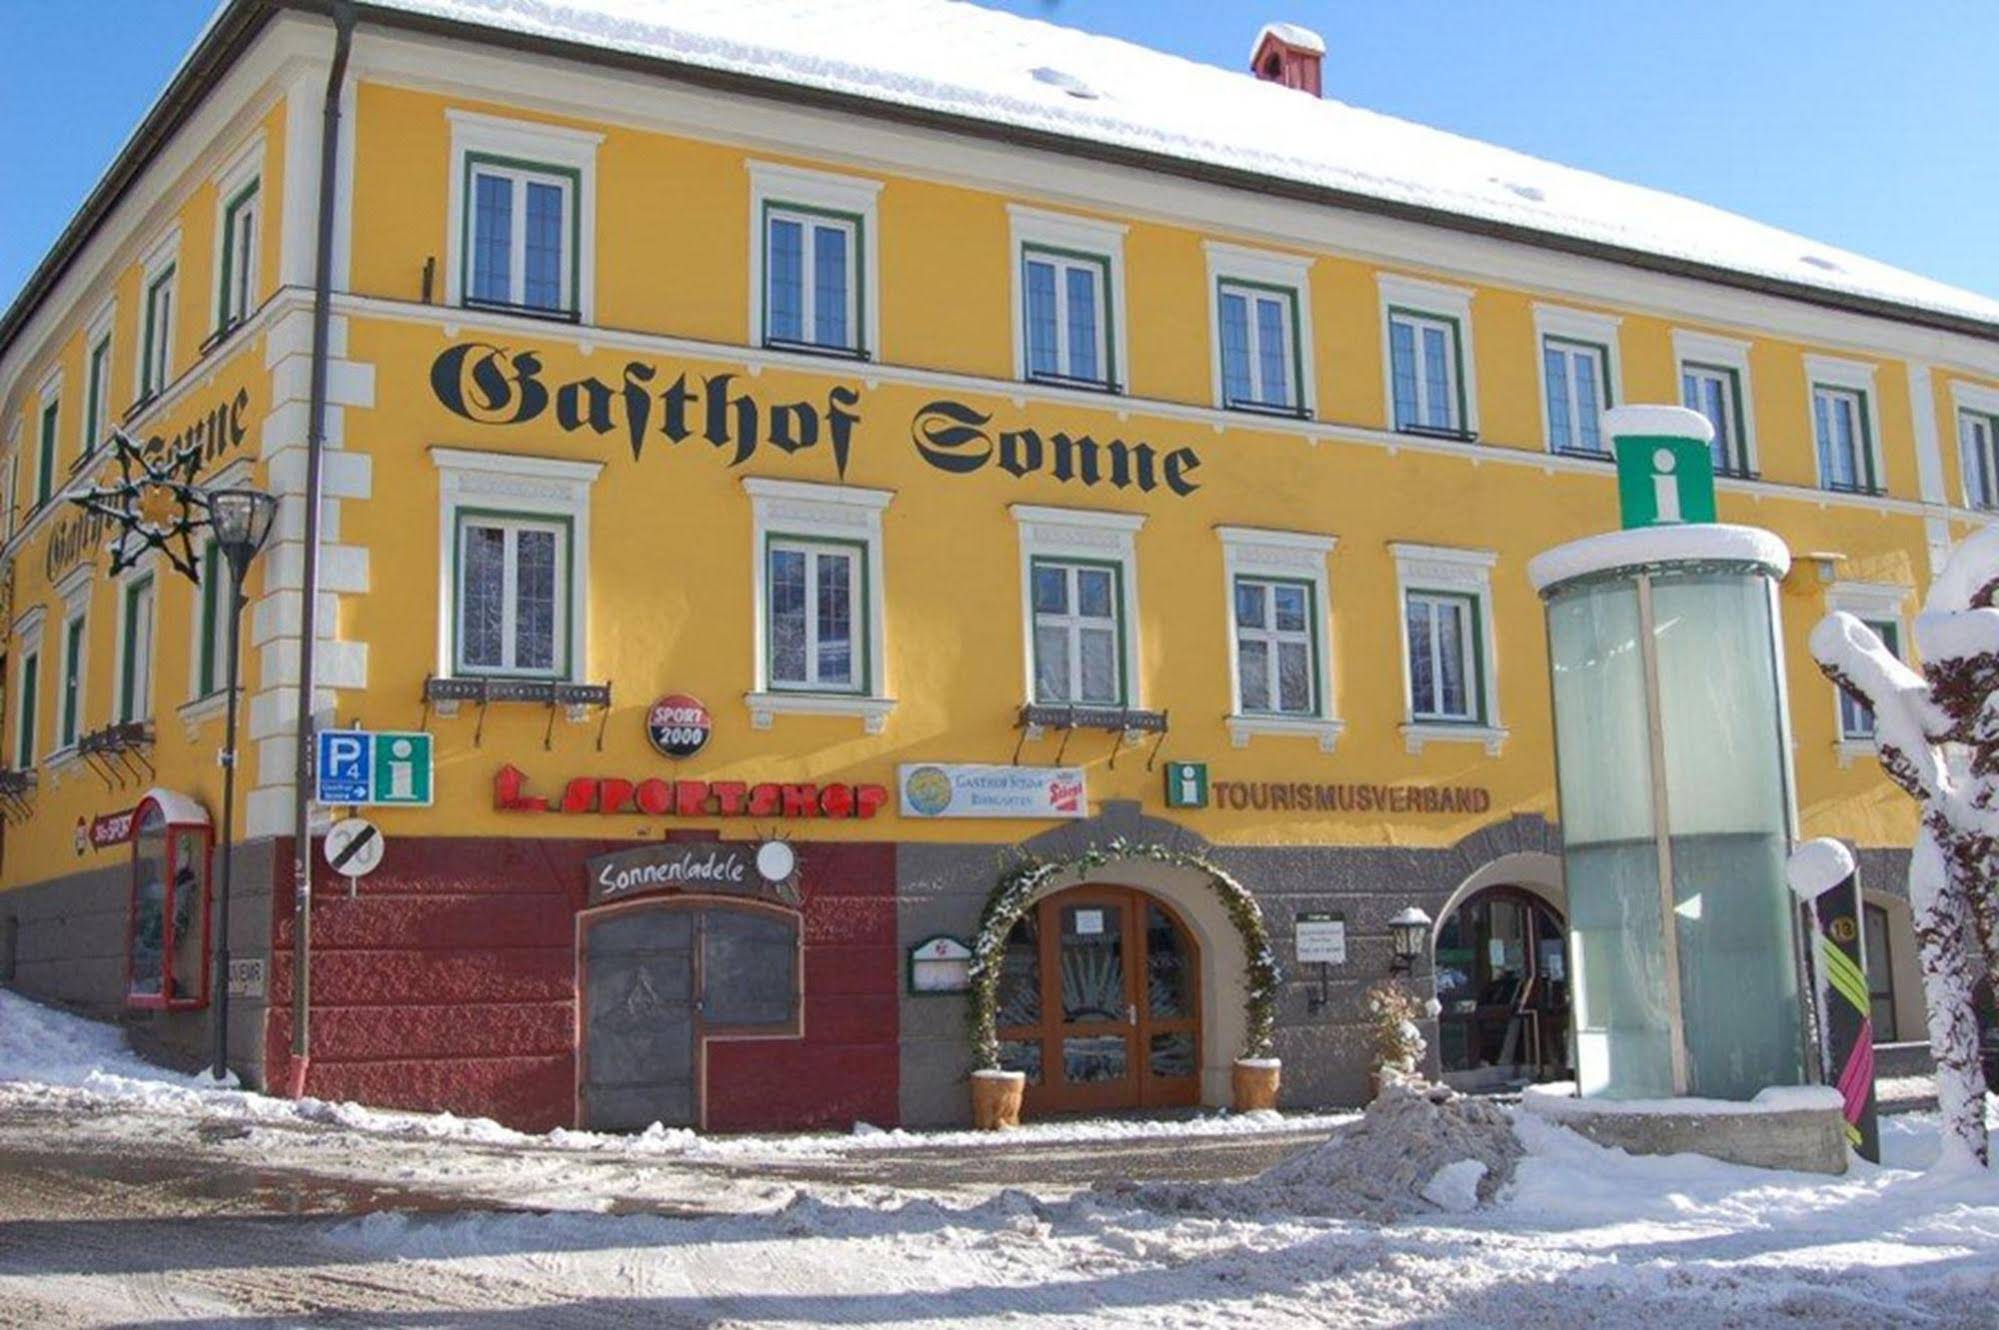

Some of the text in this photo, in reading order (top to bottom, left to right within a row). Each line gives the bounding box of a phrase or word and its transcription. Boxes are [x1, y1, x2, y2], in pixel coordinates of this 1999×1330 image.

[911, 400, 1201, 498] Sonne
[653, 706, 703, 723] SPORT
[659, 726, 703, 745] 2000
[330, 738, 361, 777] P
[346, 763, 360, 779] 4
[1211, 781, 1491, 814] TOURISMUSVERBAND
[600, 851, 744, 894] Sonnenladele
